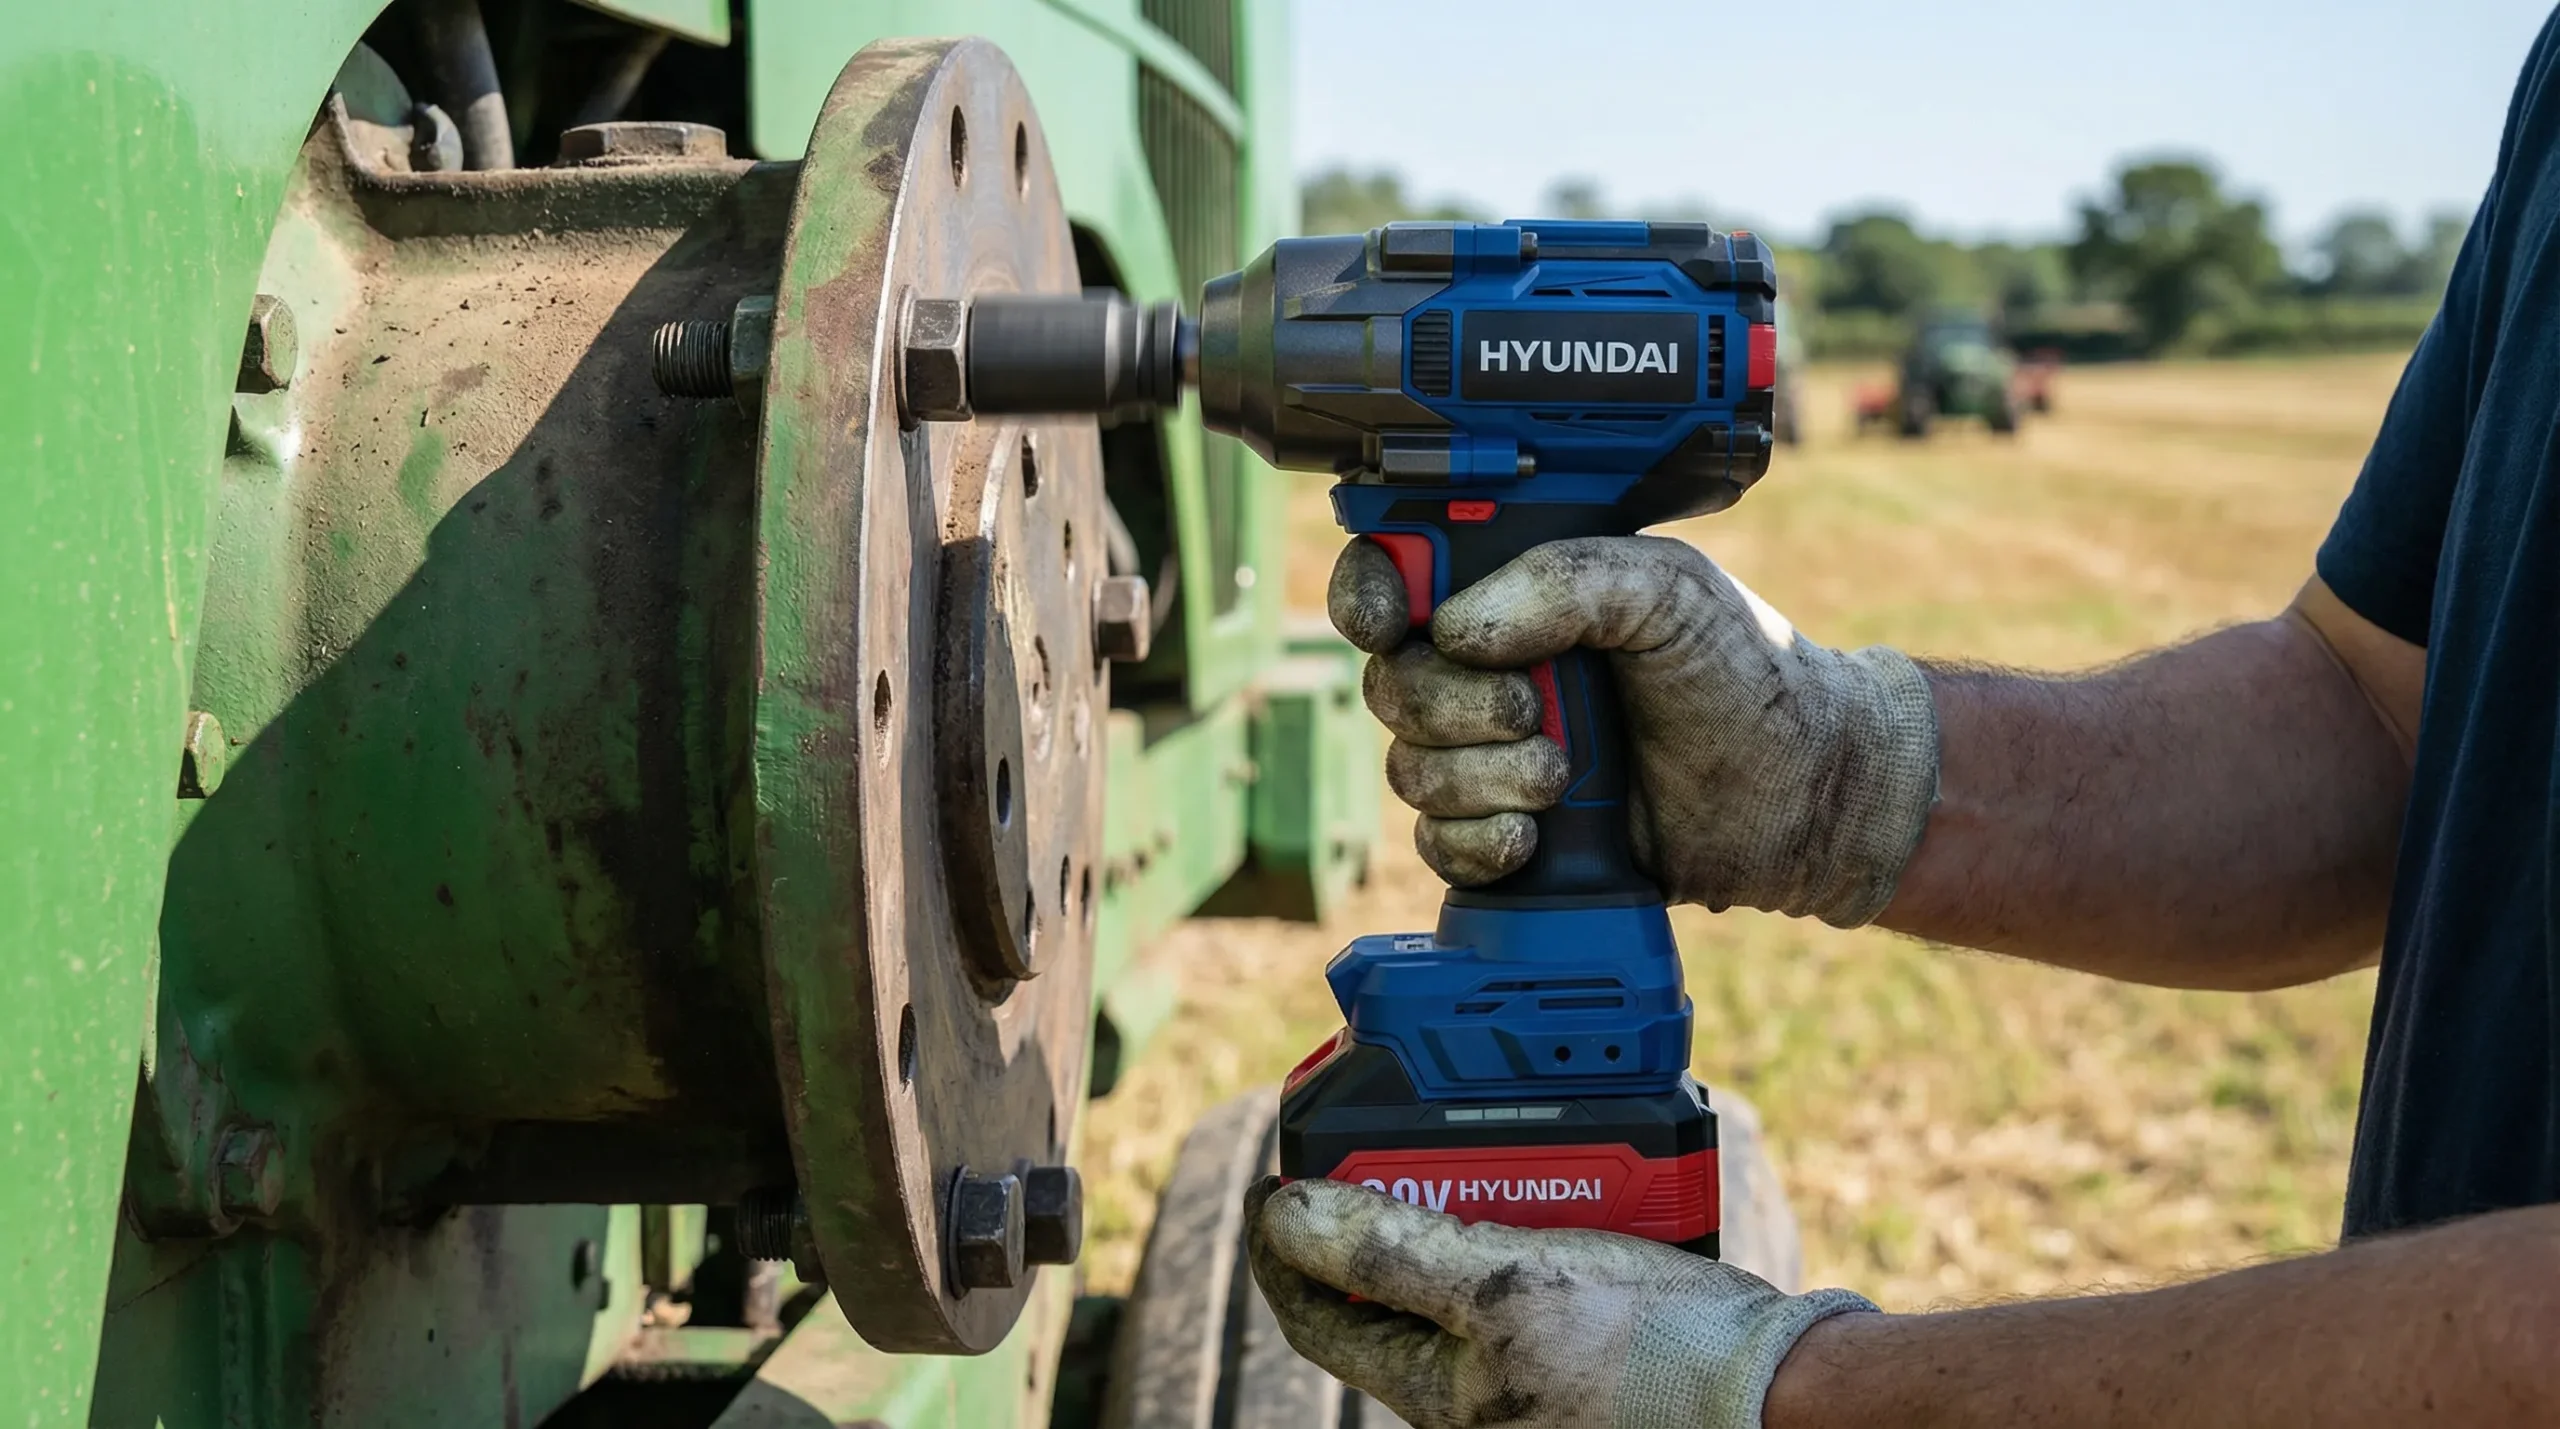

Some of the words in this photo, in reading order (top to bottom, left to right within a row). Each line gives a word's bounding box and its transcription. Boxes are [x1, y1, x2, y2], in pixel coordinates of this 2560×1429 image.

[1479, 340, 1679, 374] HYUNDAI
[1361, 1177, 1453, 1213] 0V
[1459, 1178, 1601, 1202] HYUNDAI
